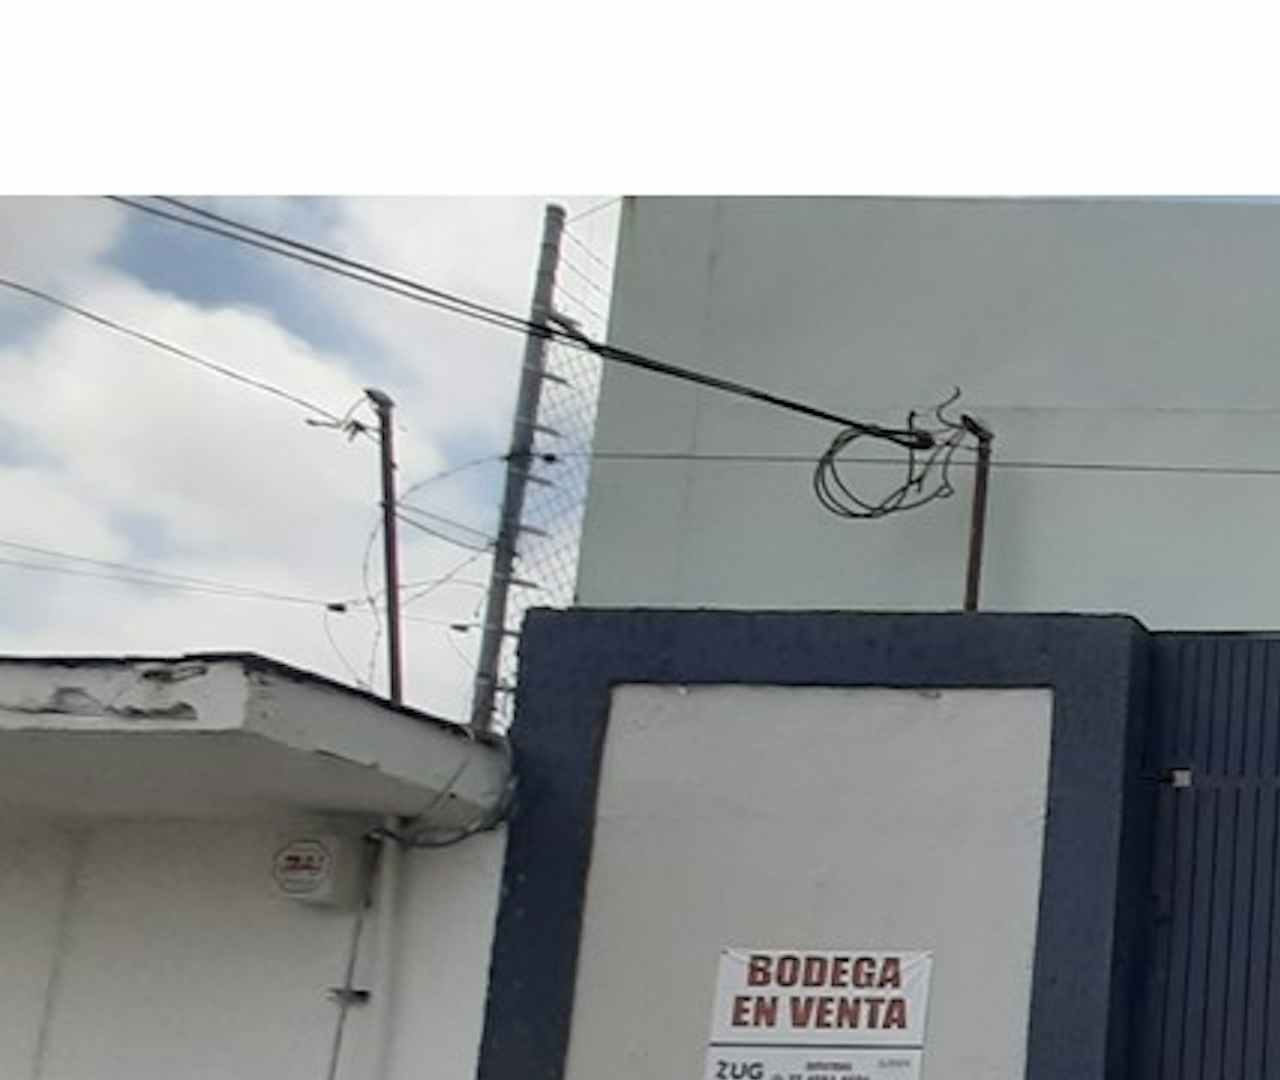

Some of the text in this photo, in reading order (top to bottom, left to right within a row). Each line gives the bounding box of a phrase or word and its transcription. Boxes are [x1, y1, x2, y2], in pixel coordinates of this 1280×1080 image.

[747, 955, 902, 989] BODEGA
[731, 996, 907, 1029] EN VENTA
[716, 1060, 765, 1080] ZUG
